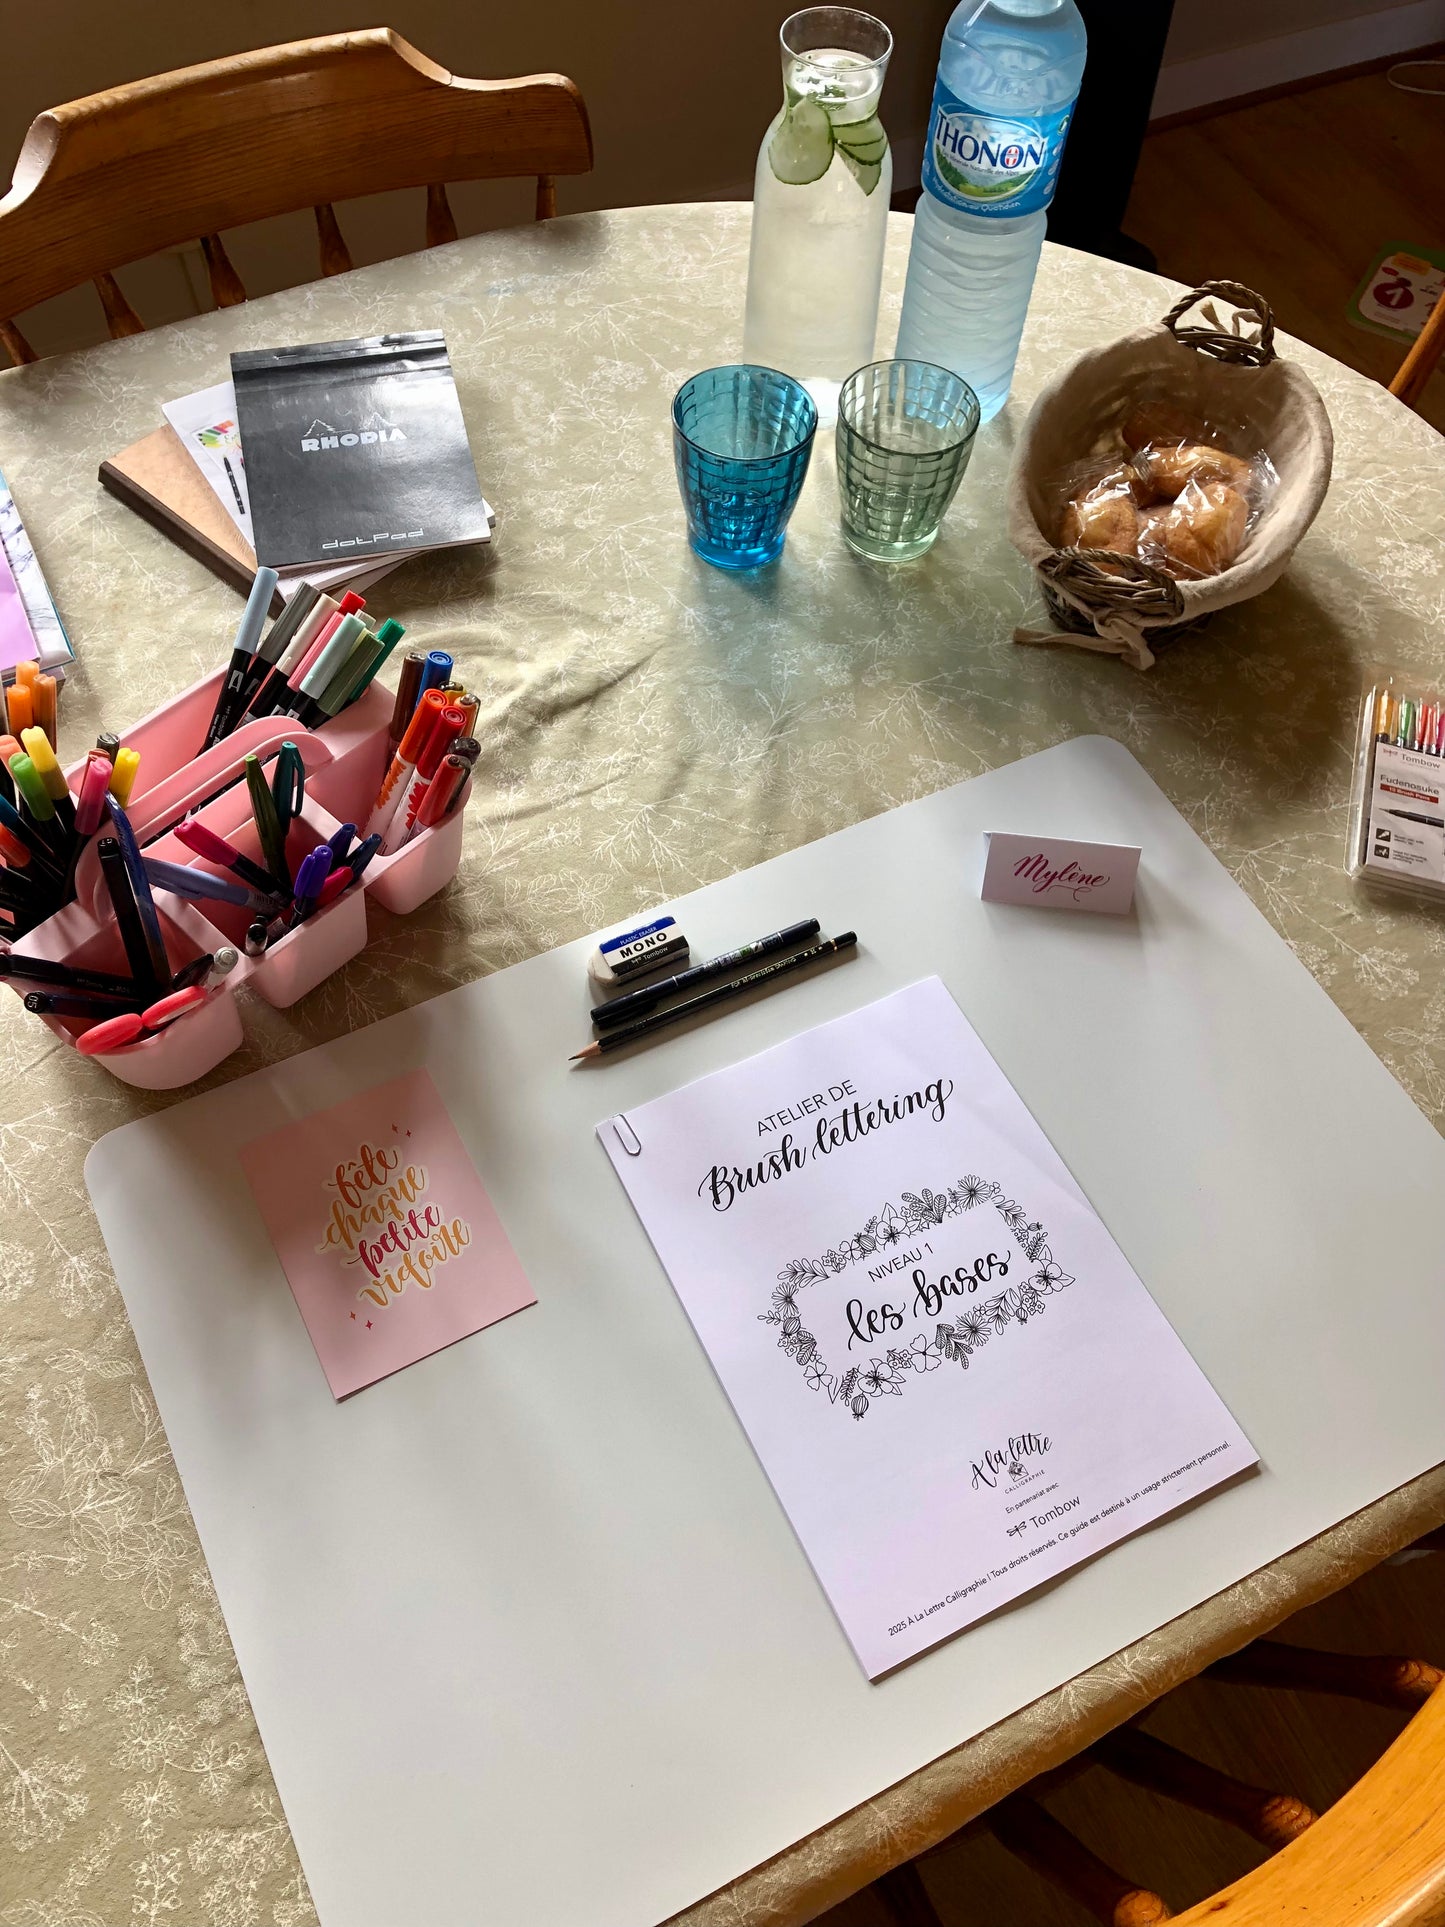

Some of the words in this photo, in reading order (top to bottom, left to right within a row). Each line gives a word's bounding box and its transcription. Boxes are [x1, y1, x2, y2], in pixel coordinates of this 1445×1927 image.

[937, 111, 1045, 169] THONON
[980, 201, 1021, 213] Quotidien
[301, 428, 408, 452] RHODIA
[322, 528, 424, 549] dotPad
[1402, 753, 1441, 769] Tombow
[1380, 774, 1440, 795] Fudenosuke
[1013, 853, 1111, 903] Mylène
[619, 933, 639, 946] PLASTIC
[639, 926, 658, 938] ERASER
[619, 932, 667, 959] MONO
[642, 946, 669, 961] Tombow
[757, 1093, 828, 1137] ATELIER
[827, 1079, 857, 1102] DE
[698, 1134, 807, 1212] Brush
[812, 1079, 954, 1160] lettering
[328, 1144, 399, 1209] fête
[320, 1166, 425, 1250] chaque
[347, 1205, 441, 1279] petite
[868, 1246, 924, 1282] NIVEAU
[924, 1242, 934, 1255] 1
[360, 1219, 470, 1307] victoire
[846, 1298, 906, 1351] les
[913, 1250, 1011, 1318] bases
[984, 1449, 1009, 1475] la
[1008, 1432, 1053, 1462] lettre
[1004, 1469, 1046, 1495] CALLIGRAPHIE
[1005, 1504, 1015, 1514] En
[1015, 1489, 1046, 1511] partenariat
[1045, 1482, 1060, 1493] avec
[1029, 1496, 1081, 1529] Tombow
[887, 1621, 908, 1637] 2025
[914, 1611, 925, 1623] La
[925, 1600, 946, 1617] Lettre
[945, 1577, 988, 1604] Calligraphie
[990, 1566, 1009, 1578] Tous
[1009, 1555, 1029, 1569] droits
[1028, 1538, 1059, 1559] réservés.
[1058, 1531, 1070, 1542] Ce
[1069, 1521, 1089, 1537] guide
[1089, 1514, 1102, 1525] est
[1101, 1501, 1126, 1518] destiné
[1125, 1496, 1131, 1504] à
[1131, 1492, 1141, 1501] un
[1140, 1480, 1162, 1496] usage
[1161, 1459, 1198, 1484] strictement
[1197, 1440, 1232, 1466] personnel.
